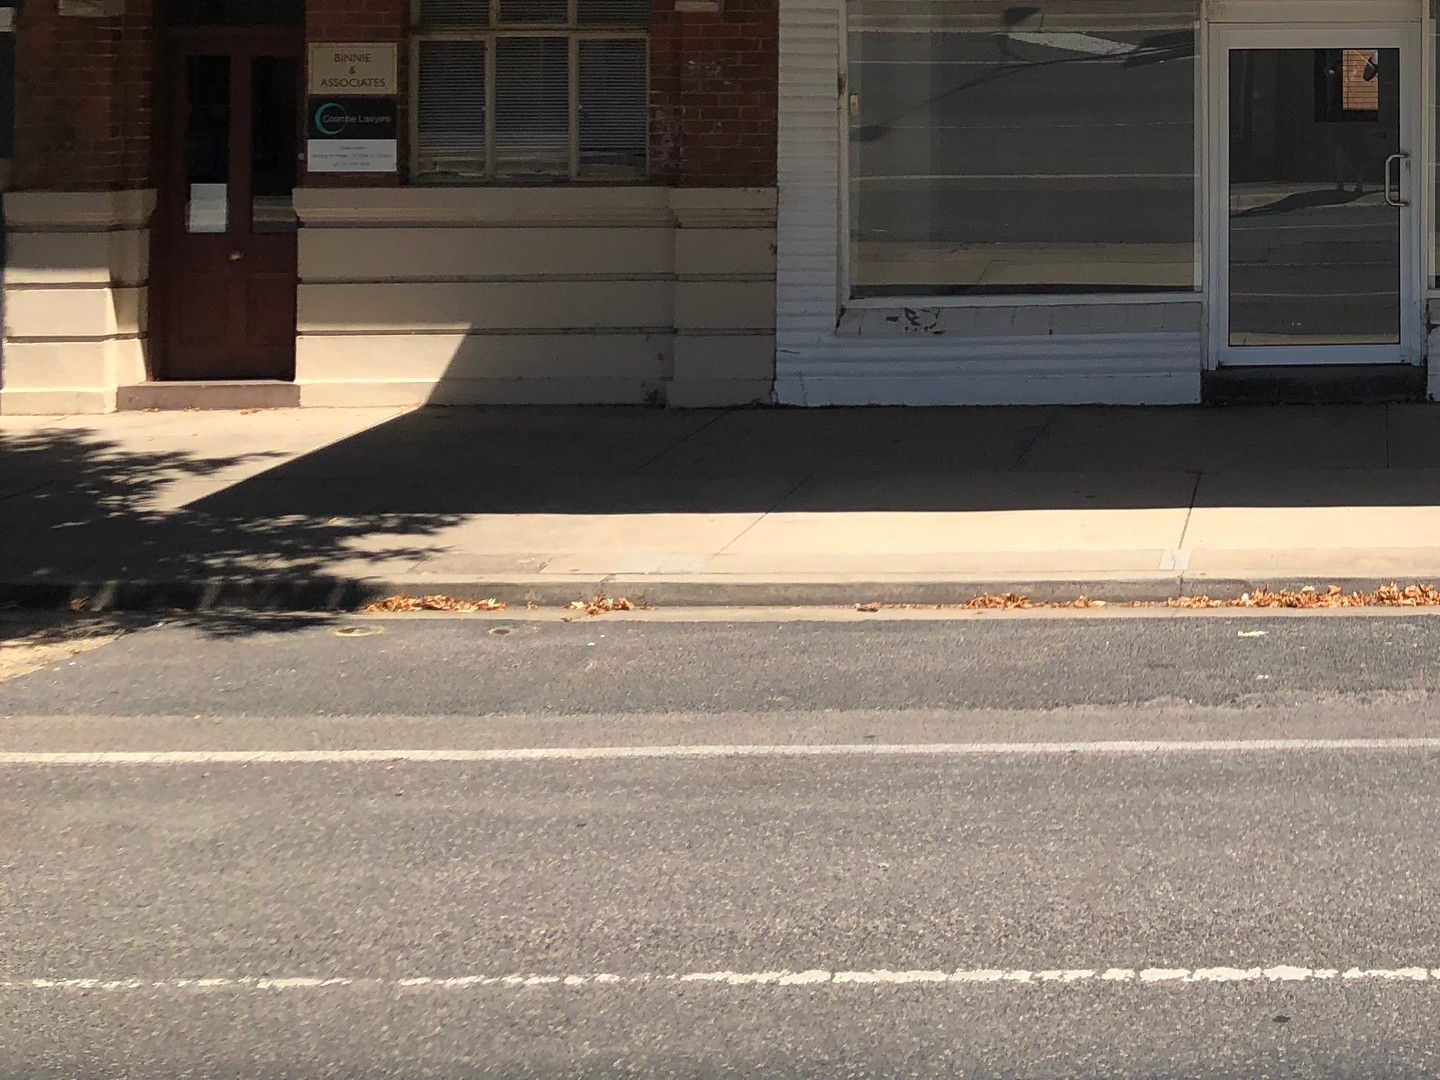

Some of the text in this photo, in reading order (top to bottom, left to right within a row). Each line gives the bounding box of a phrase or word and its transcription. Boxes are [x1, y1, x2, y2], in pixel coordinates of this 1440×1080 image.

[334, 53, 372, 63] BINNIE
[348, 65, 356, 75] &
[320, 78, 386, 88] ASSOCIATES
